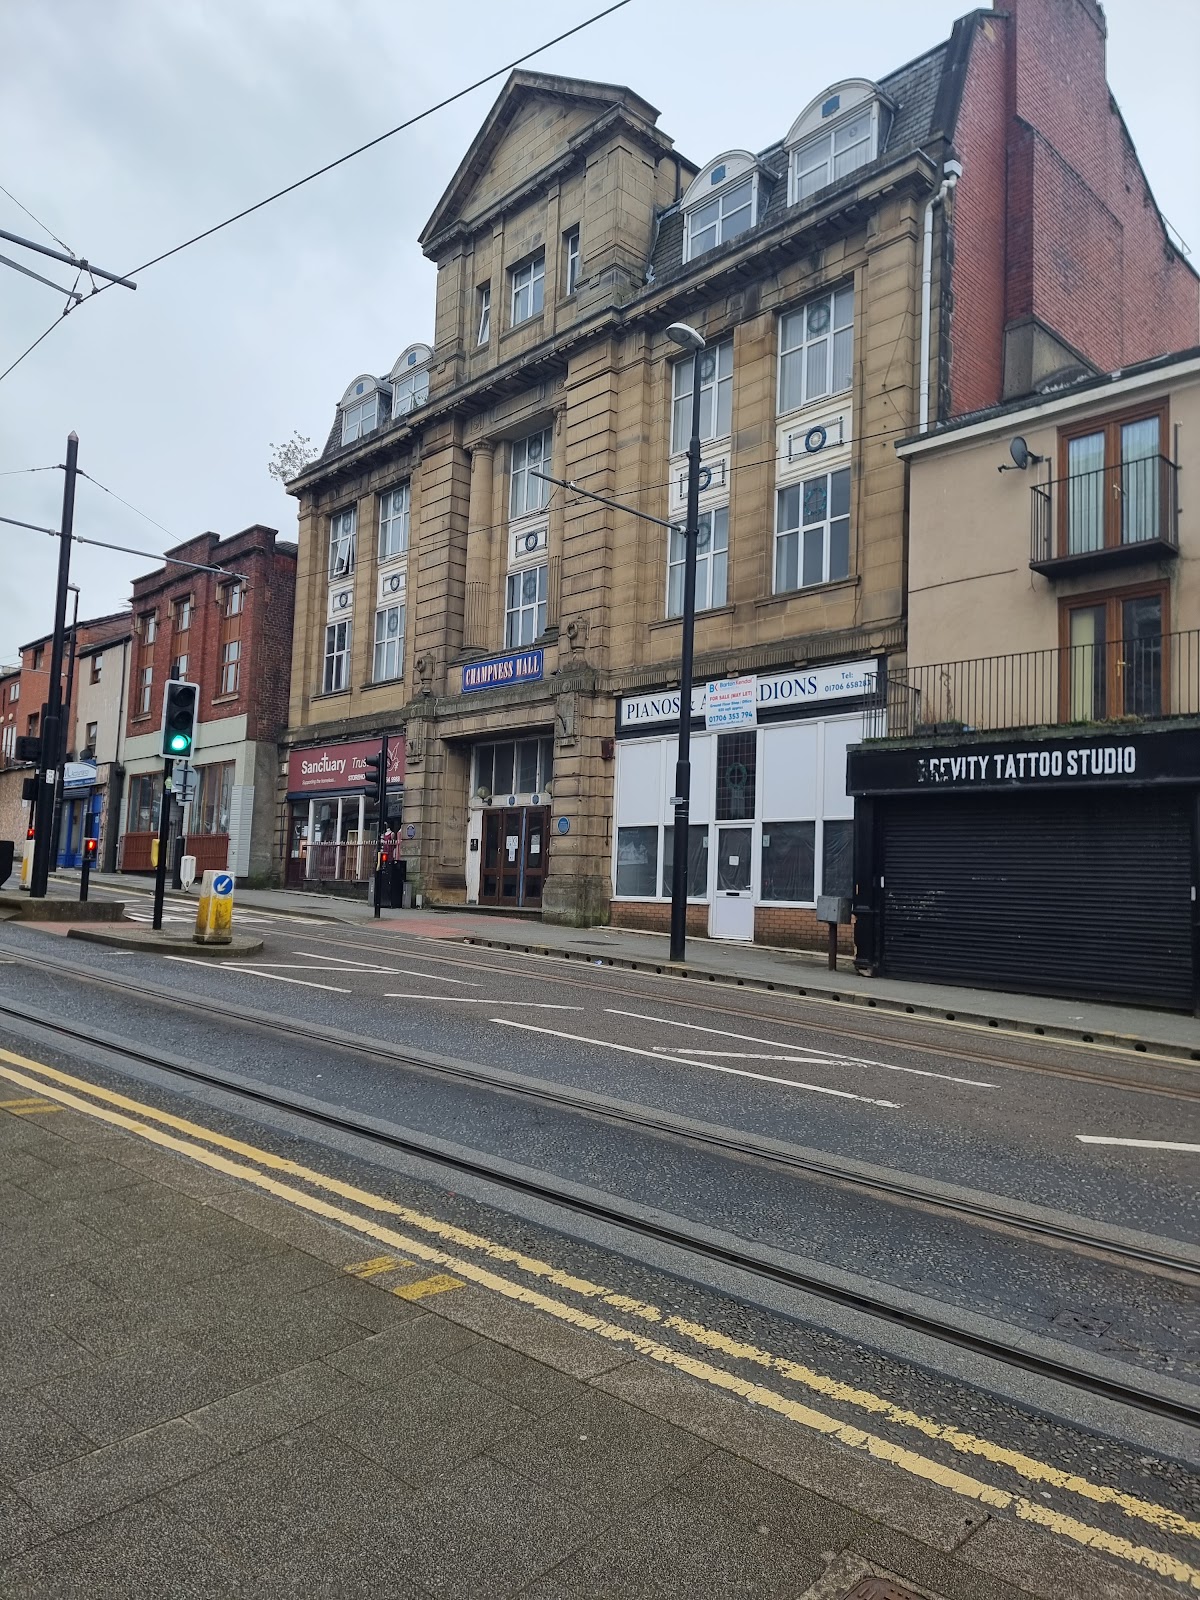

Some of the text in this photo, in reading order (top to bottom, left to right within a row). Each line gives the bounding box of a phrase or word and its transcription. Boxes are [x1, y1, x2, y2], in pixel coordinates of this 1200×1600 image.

[466, 656, 539, 686] CHAMPNESS HALL
[841, 671, 854, 680] Tel:
[824, 683, 844, 692] 01706
[627, 697, 680, 720] PIANOS
[708, 714, 727, 723] 01706
[728, 712, 740, 720] 353
[741, 710, 753, 719] 794
[301, 752, 346, 774] Sanctuary
[352, 757, 370, 769] Trus
[993, 750, 1063, 779] TATTOO
[1066, 746, 1136, 776] STUDIO
